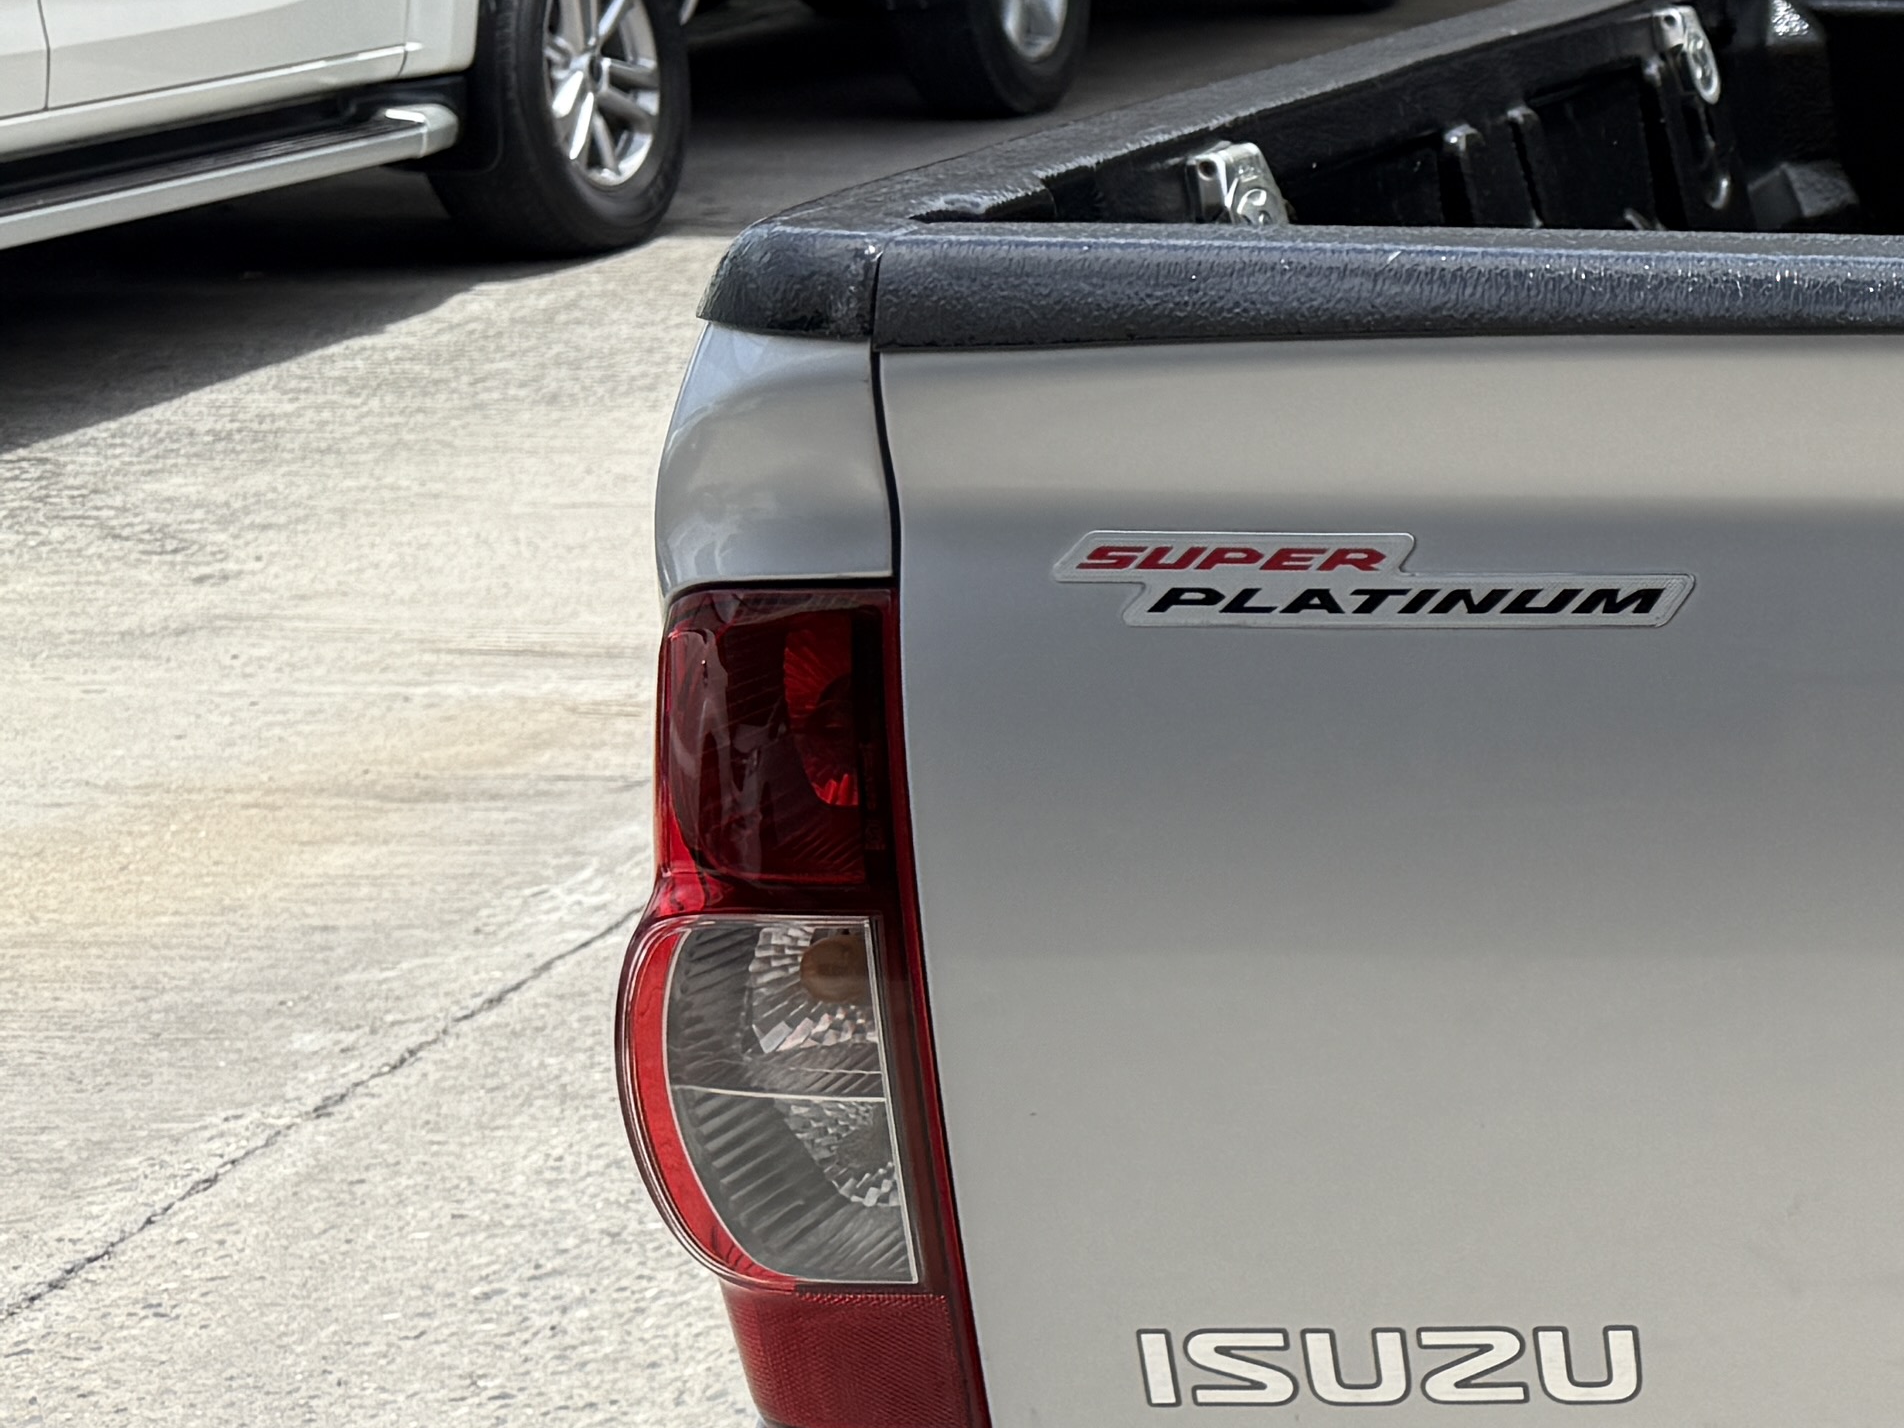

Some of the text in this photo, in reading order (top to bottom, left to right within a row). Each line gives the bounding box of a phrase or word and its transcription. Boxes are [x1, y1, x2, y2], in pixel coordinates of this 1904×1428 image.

[1075, 545, 1388, 572] SUPER
[1146, 587, 1668, 615] PLATINUM
[1136, 1325, 1643, 1407] ISUZU
